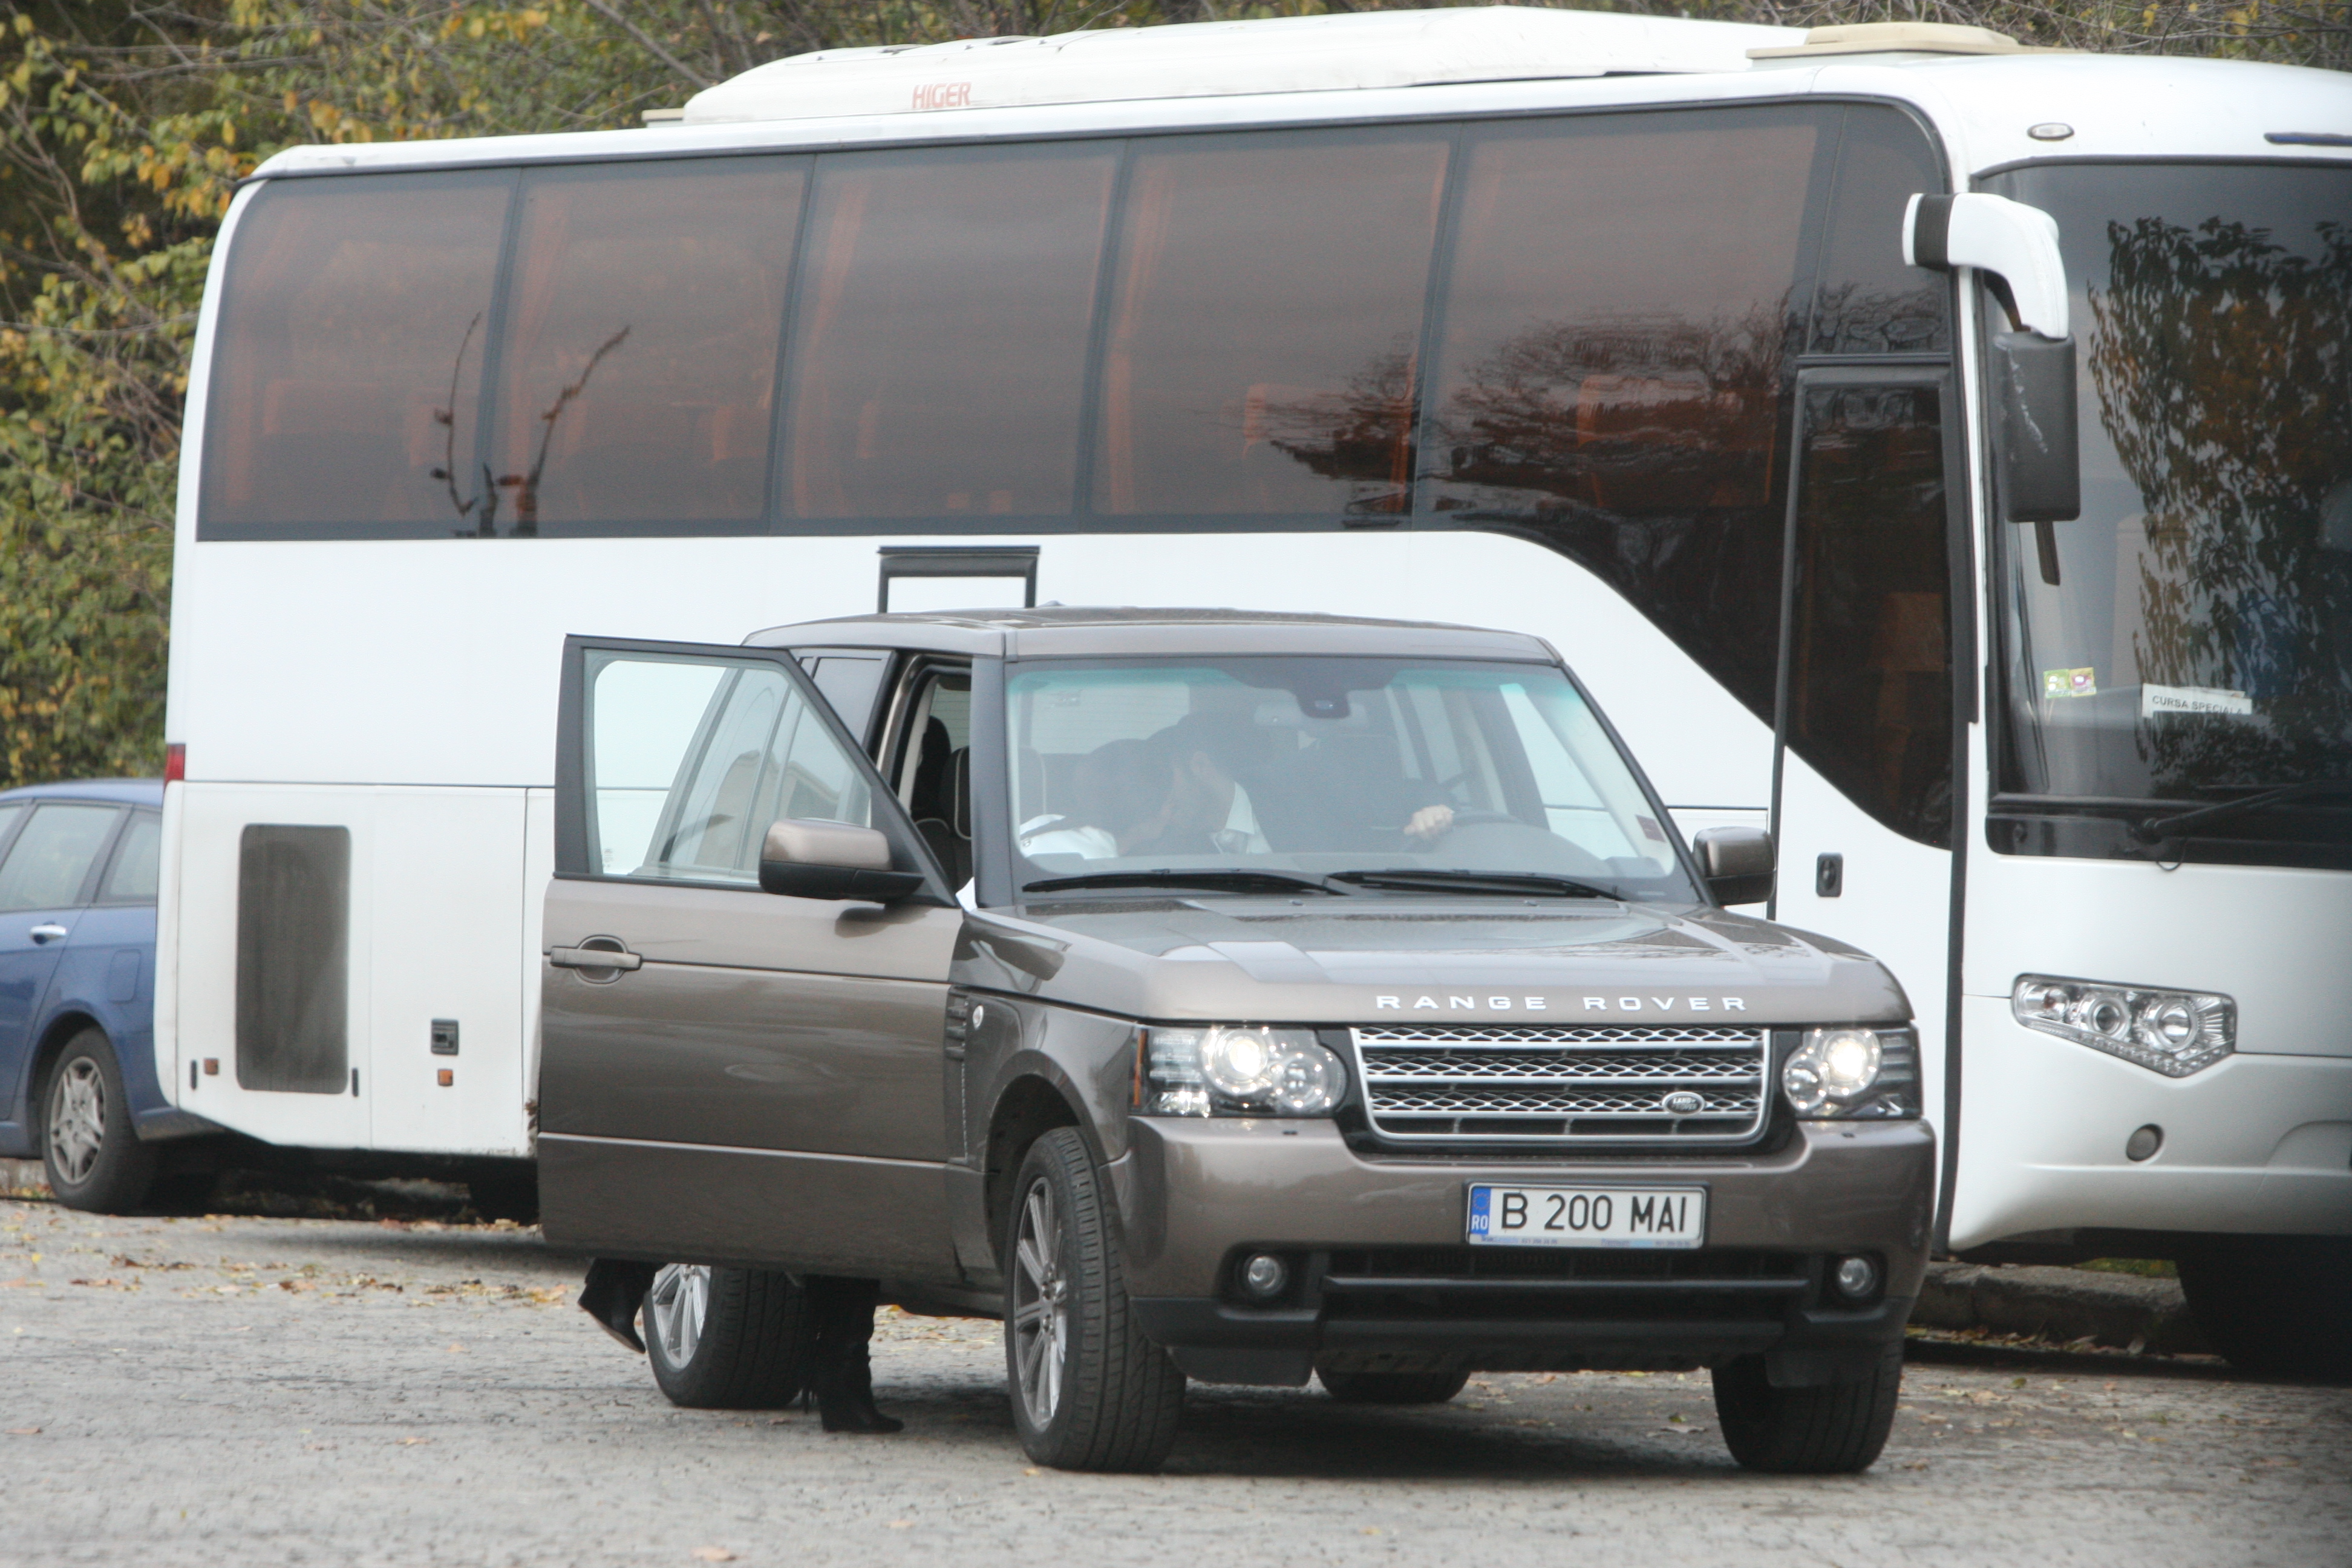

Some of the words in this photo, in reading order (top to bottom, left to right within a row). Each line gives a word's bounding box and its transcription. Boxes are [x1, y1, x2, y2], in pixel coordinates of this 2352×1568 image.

[913, 82, 972, 109] HIGER
[2152, 695, 2188, 708] CURSA
[1376, 996, 1547, 1010] RANGE
[1583, 996, 1747, 1011] ROVER
[1501, 1192, 1529, 1230] B
[1544, 1194, 1613, 1231] 200
[1630, 1195, 1687, 1233] MAI
[1471, 1215, 1488, 1231] RO
